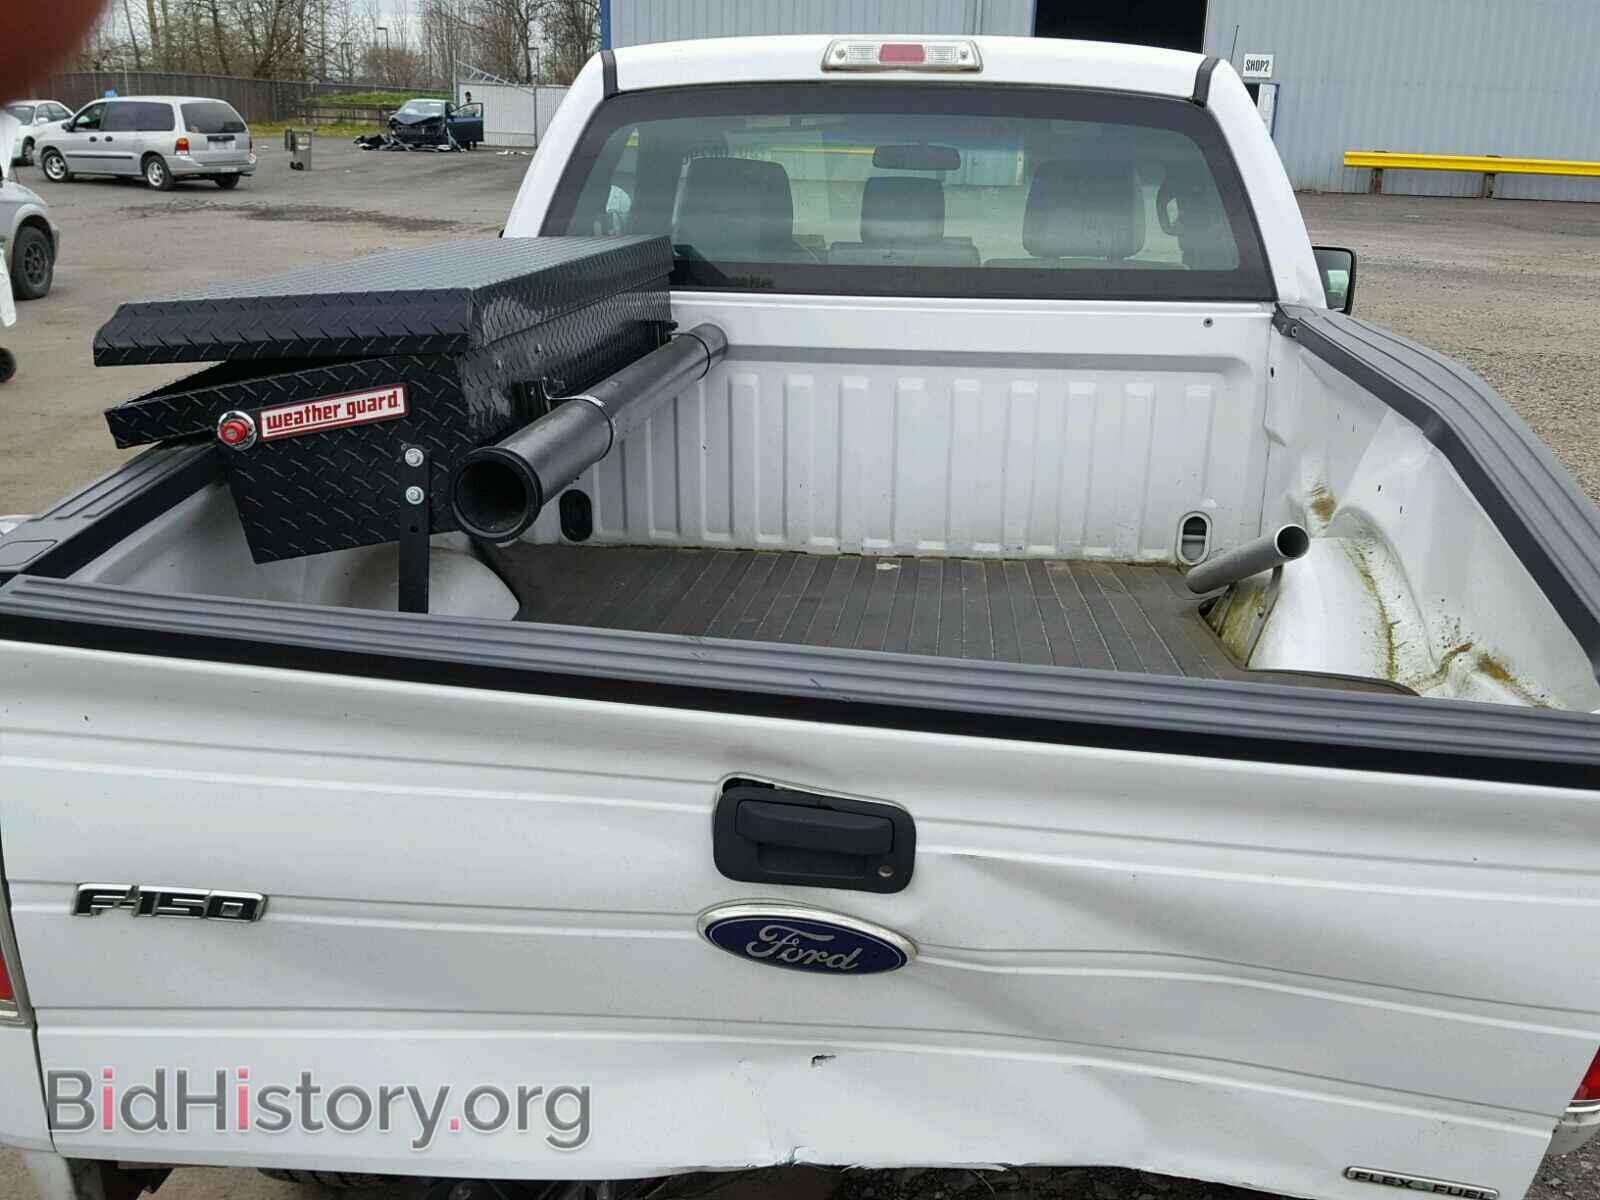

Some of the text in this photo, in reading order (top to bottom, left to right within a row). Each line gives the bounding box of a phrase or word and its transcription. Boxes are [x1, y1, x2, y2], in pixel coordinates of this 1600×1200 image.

[266, 390, 400, 430] weather guard
[73, 883, 267, 922] F-150
[745, 924, 864, 970] Ford
[1354, 1171, 1495, 1200] FLEX FUEL
